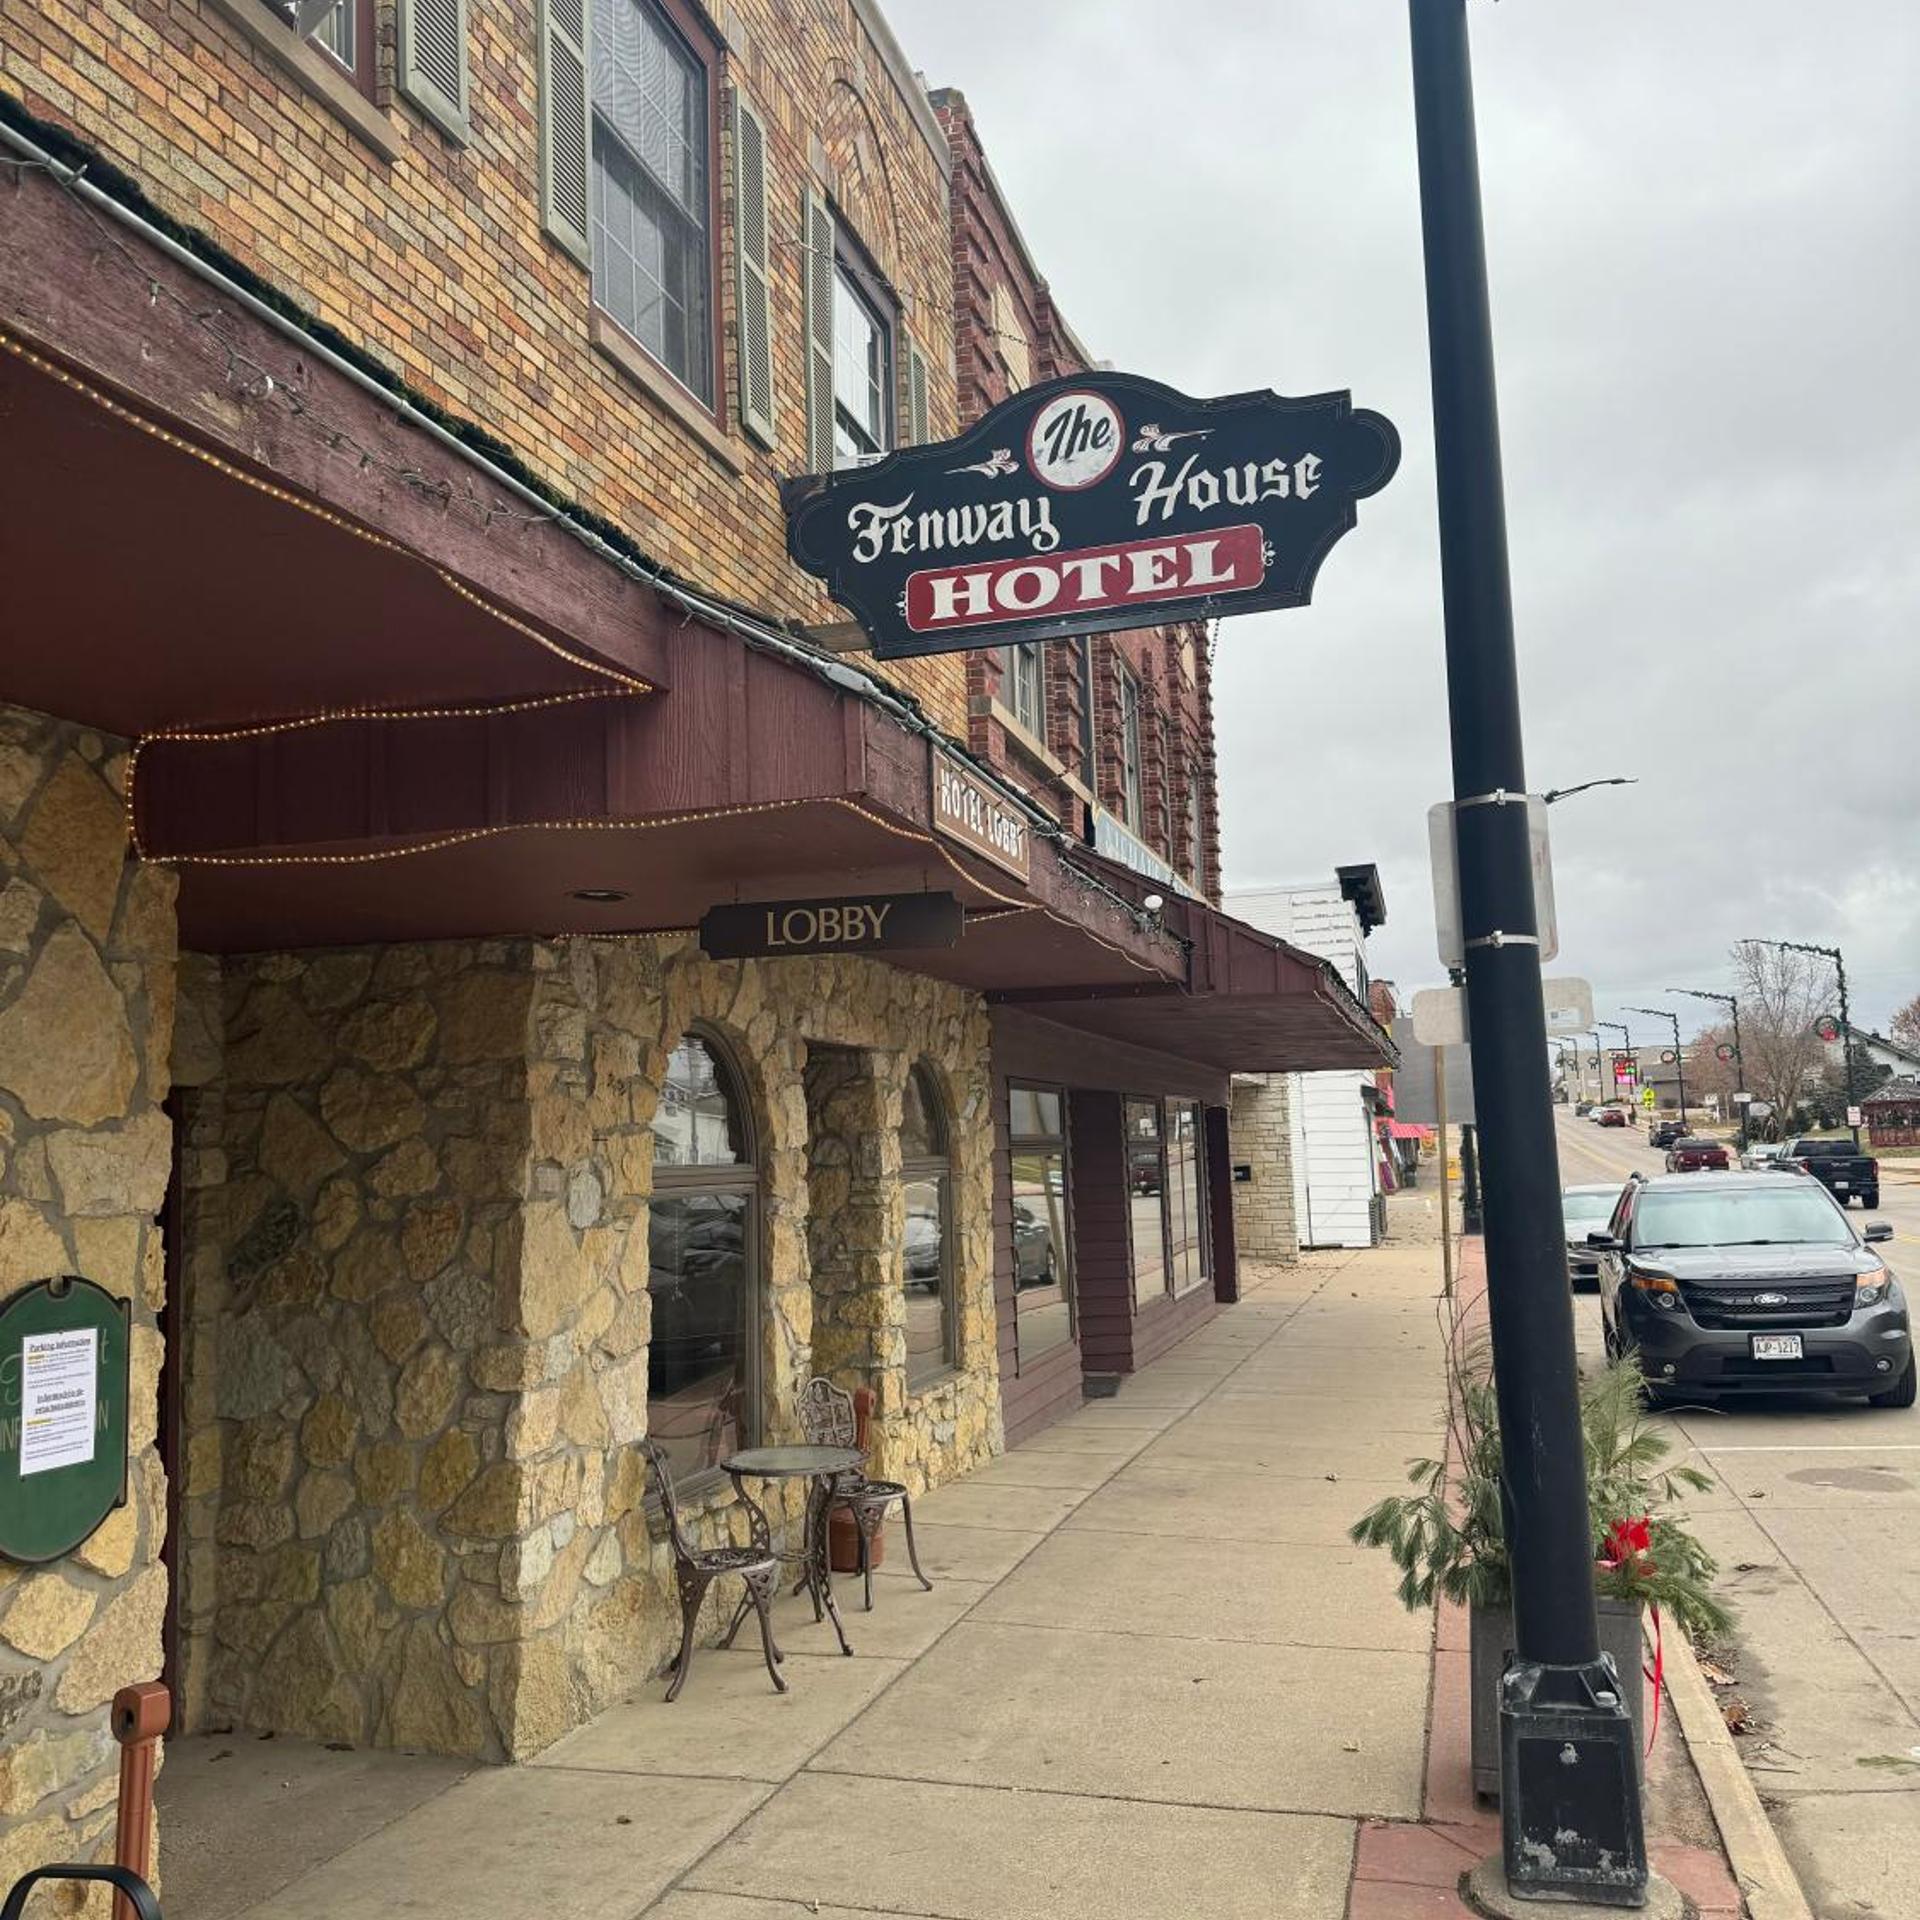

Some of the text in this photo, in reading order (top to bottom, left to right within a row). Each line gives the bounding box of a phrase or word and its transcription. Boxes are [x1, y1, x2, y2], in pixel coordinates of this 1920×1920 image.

[1044, 406, 1112, 466] The
[848, 451, 1324, 563] Fenway House
[929, 538, 1236, 621] HOTEL
[941, 768, 984, 836] HOTEL
[987, 804, 1023, 861] LOBBY
[766, 902, 891, 947] LOBBY
